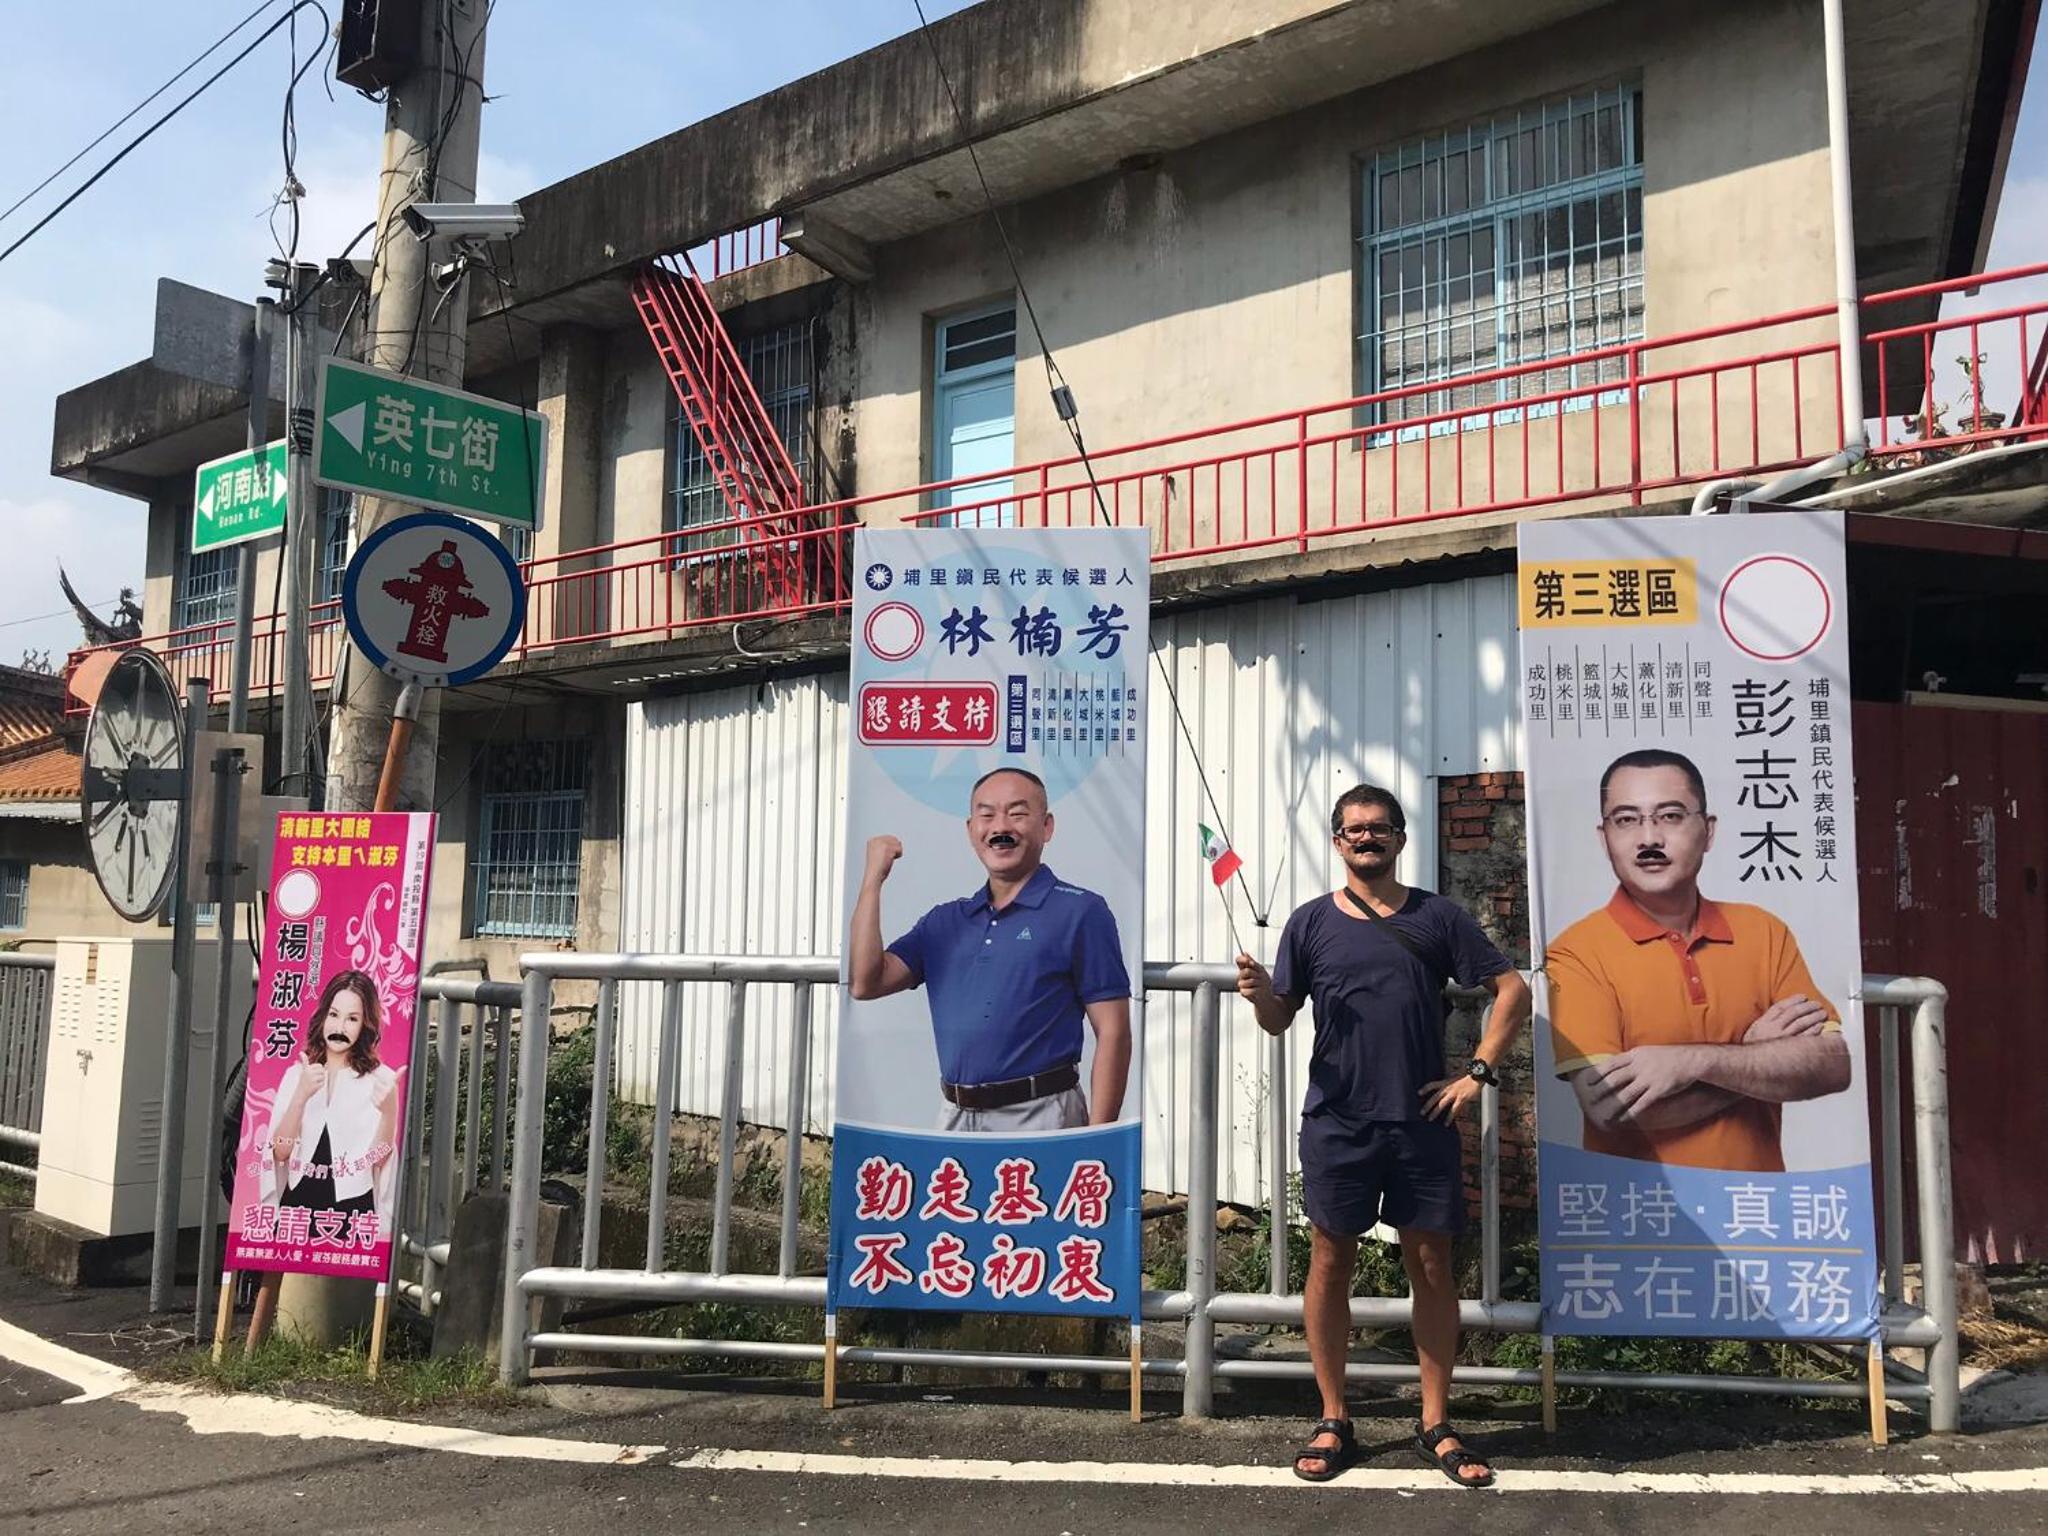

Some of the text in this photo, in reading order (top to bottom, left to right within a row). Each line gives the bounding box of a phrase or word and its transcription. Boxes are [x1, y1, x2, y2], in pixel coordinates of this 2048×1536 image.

[373, 394, 500, 472] 英七街
[214, 461, 272, 512] 河南路
[367, 452, 500, 496] Ying 7th St.
[248, 506, 263, 520] Rd.
[416, 583, 448, 648] 救火栓
[1534, 569, 1678, 619] 第三選區
[938, 602, 1130, 659] 林楠芳
[866, 694, 991, 732] 懇請支持
[1009, 682, 1024, 746] 第三選區
[1046, 687, 1058, 741] 清新里
[1078, 687, 1089, 741] 大城里
[1094, 687, 1105, 741] 桃米里
[1126, 687, 1137, 741] 成功里
[1528, 663, 1547, 720] 成功里
[1556, 662, 1575, 720] 桃米里
[1611, 661, 1630, 719] 大城里
[1637, 661, 1657, 719] 薰化里
[1665, 661, 1685, 718] 清新里
[1693, 660, 1713, 718] 同聲里
[1732, 678, 1804, 882] 彭志杰
[1808, 677, 1838, 883] 埔里鎮民代表候選人
[280, 817, 372, 838] 清新里大團結
[266, 923, 308, 1058] 楊淑芬
[855, 1156, 1114, 1228] 勤走基層
[241, 1204, 381, 1250] 懇請支持
[850, 1231, 1116, 1303] 不忘初衷
[1557, 1254, 1852, 1326] 志在服務
